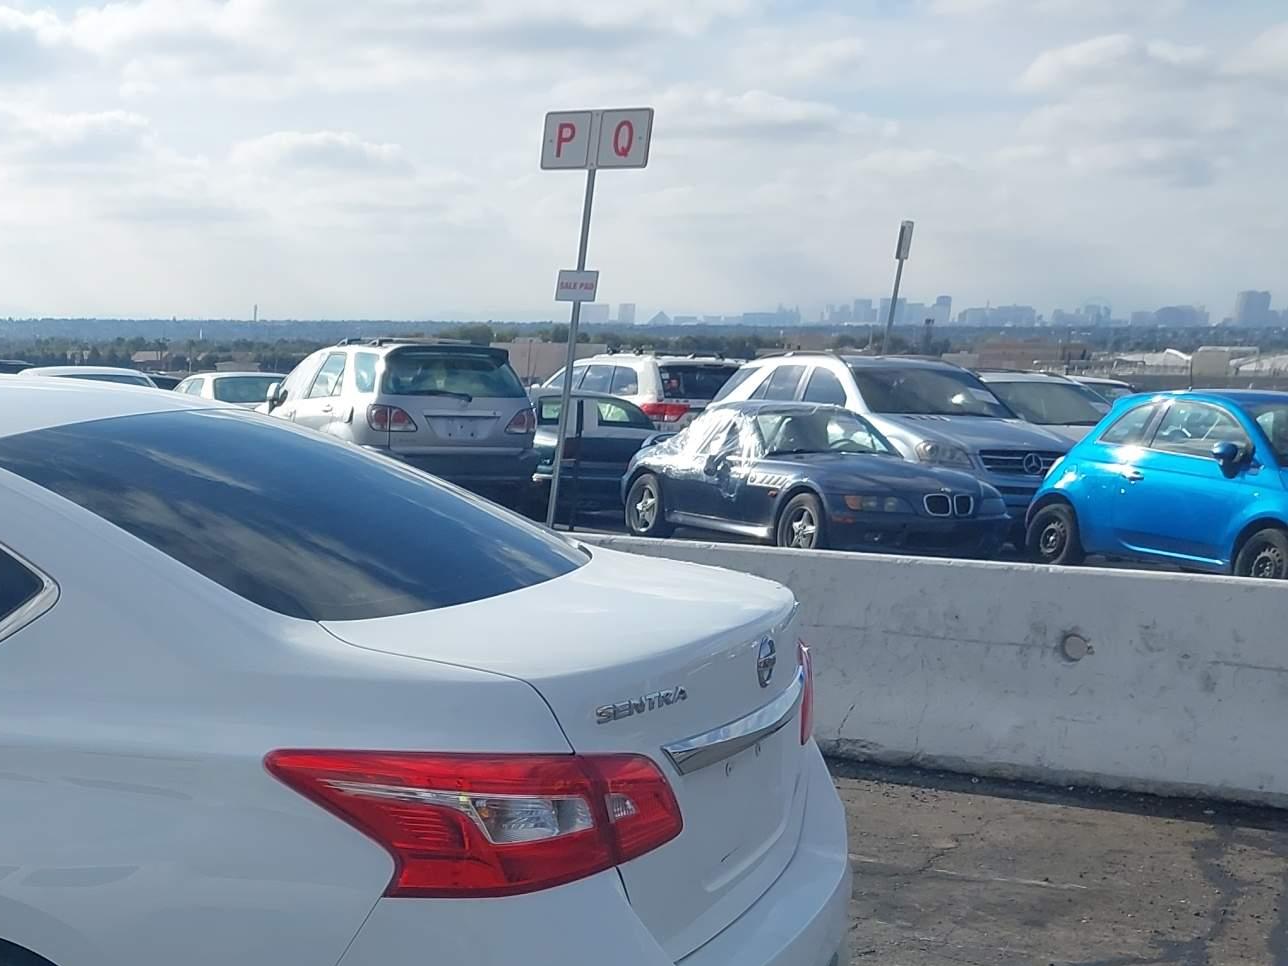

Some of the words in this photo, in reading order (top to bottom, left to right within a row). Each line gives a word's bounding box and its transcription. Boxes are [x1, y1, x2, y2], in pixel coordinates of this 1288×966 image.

[554, 122, 576, 158] P
[612, 119, 634, 158] Q
[560, 281, 577, 290] SALE
[594, 686, 688, 725] SENTRA
